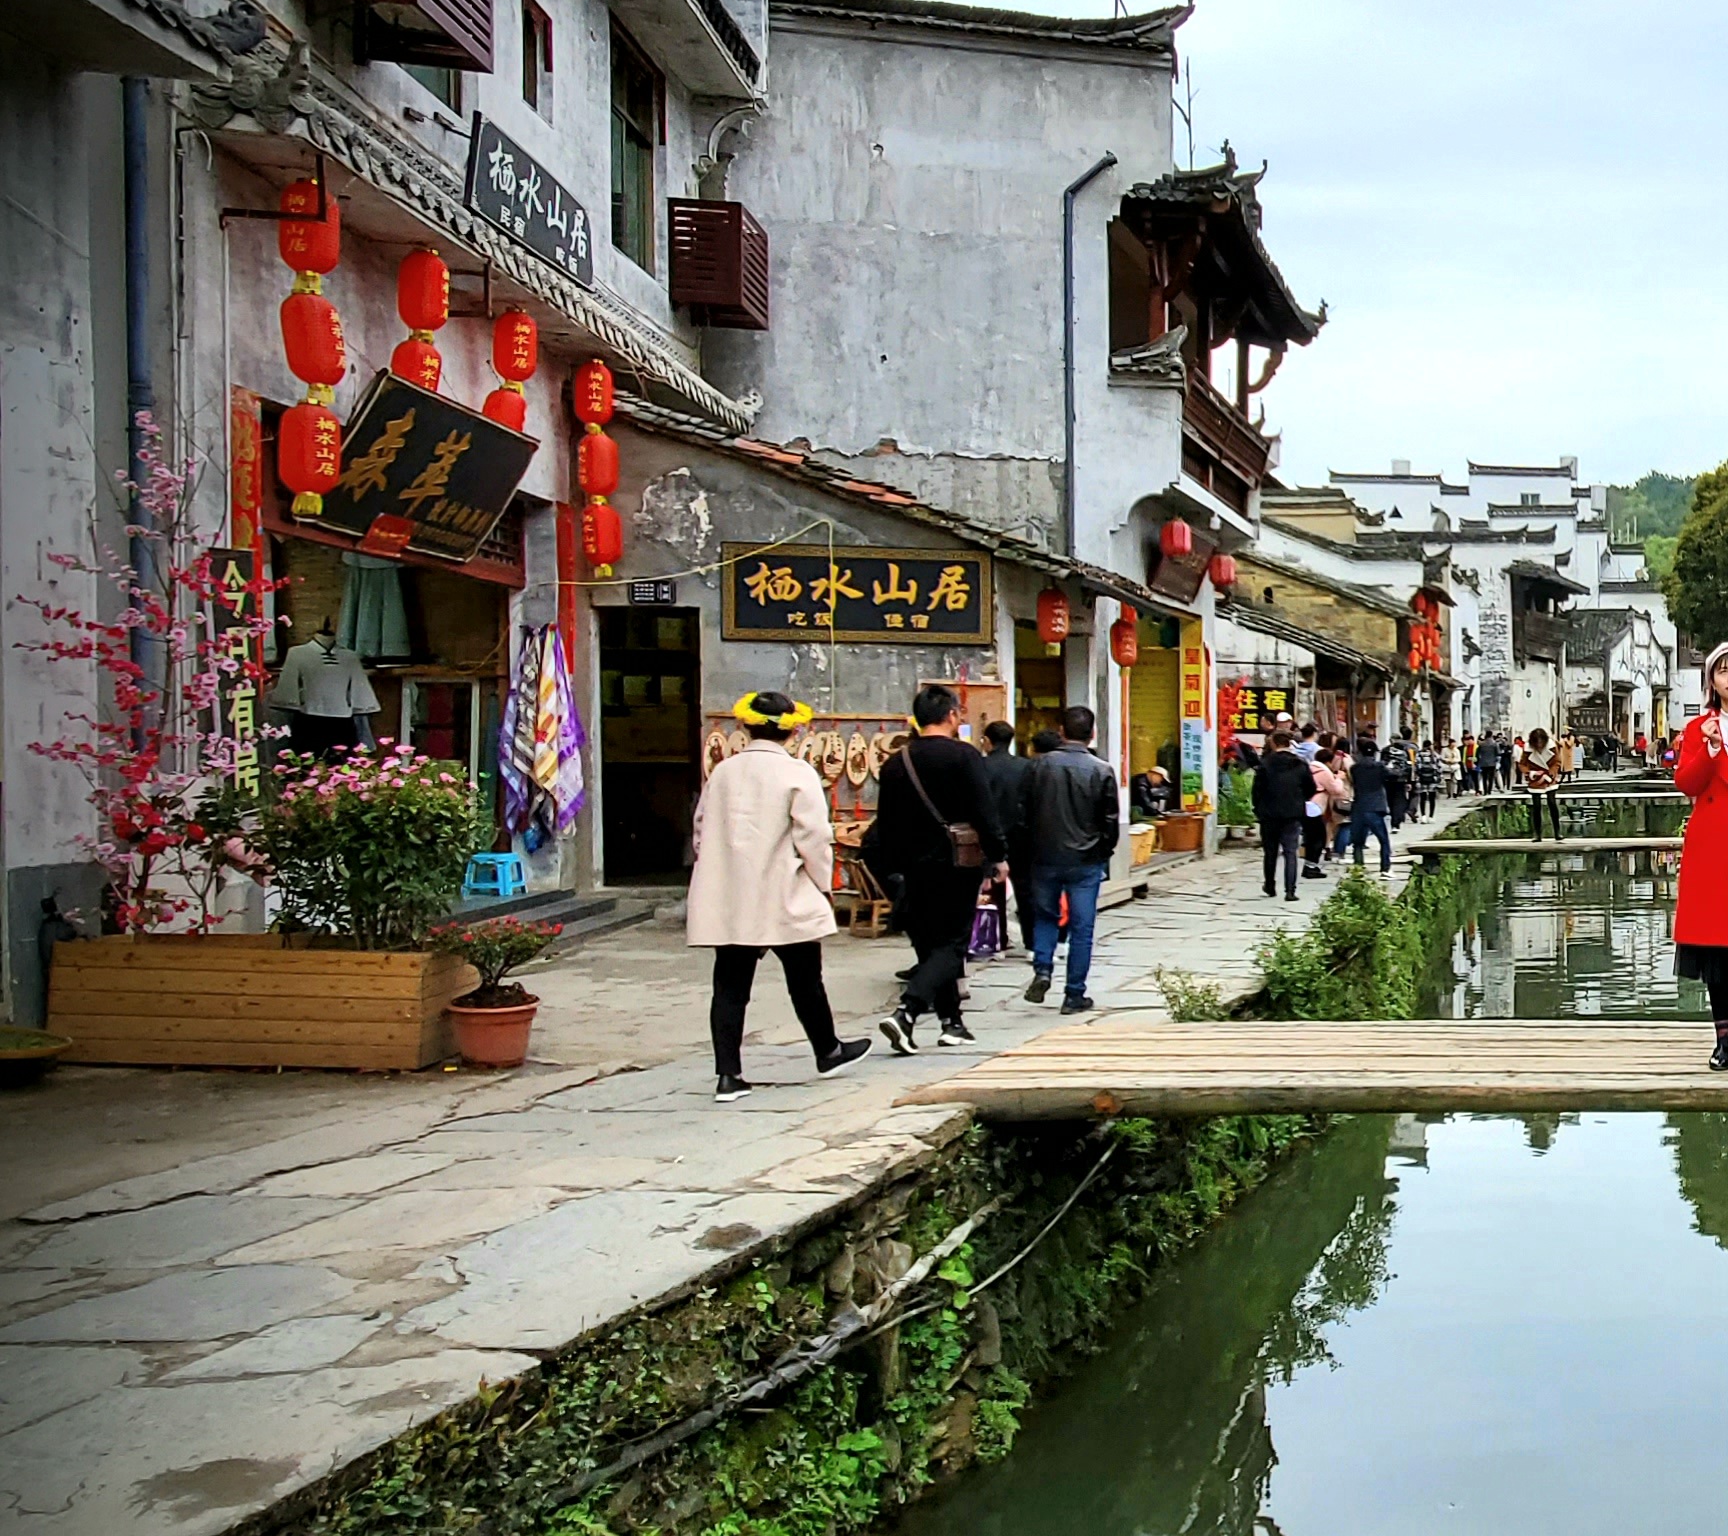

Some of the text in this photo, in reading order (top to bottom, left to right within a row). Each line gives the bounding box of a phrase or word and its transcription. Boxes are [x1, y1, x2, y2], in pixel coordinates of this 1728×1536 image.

[287, 193, 307, 252] 栖山居
[488, 139, 587, 260] 栖水山居
[314, 416, 337, 477] 栖水山居
[744, 562, 971, 611] 栖水山居
[1236, 689, 1287, 711] 住宿
